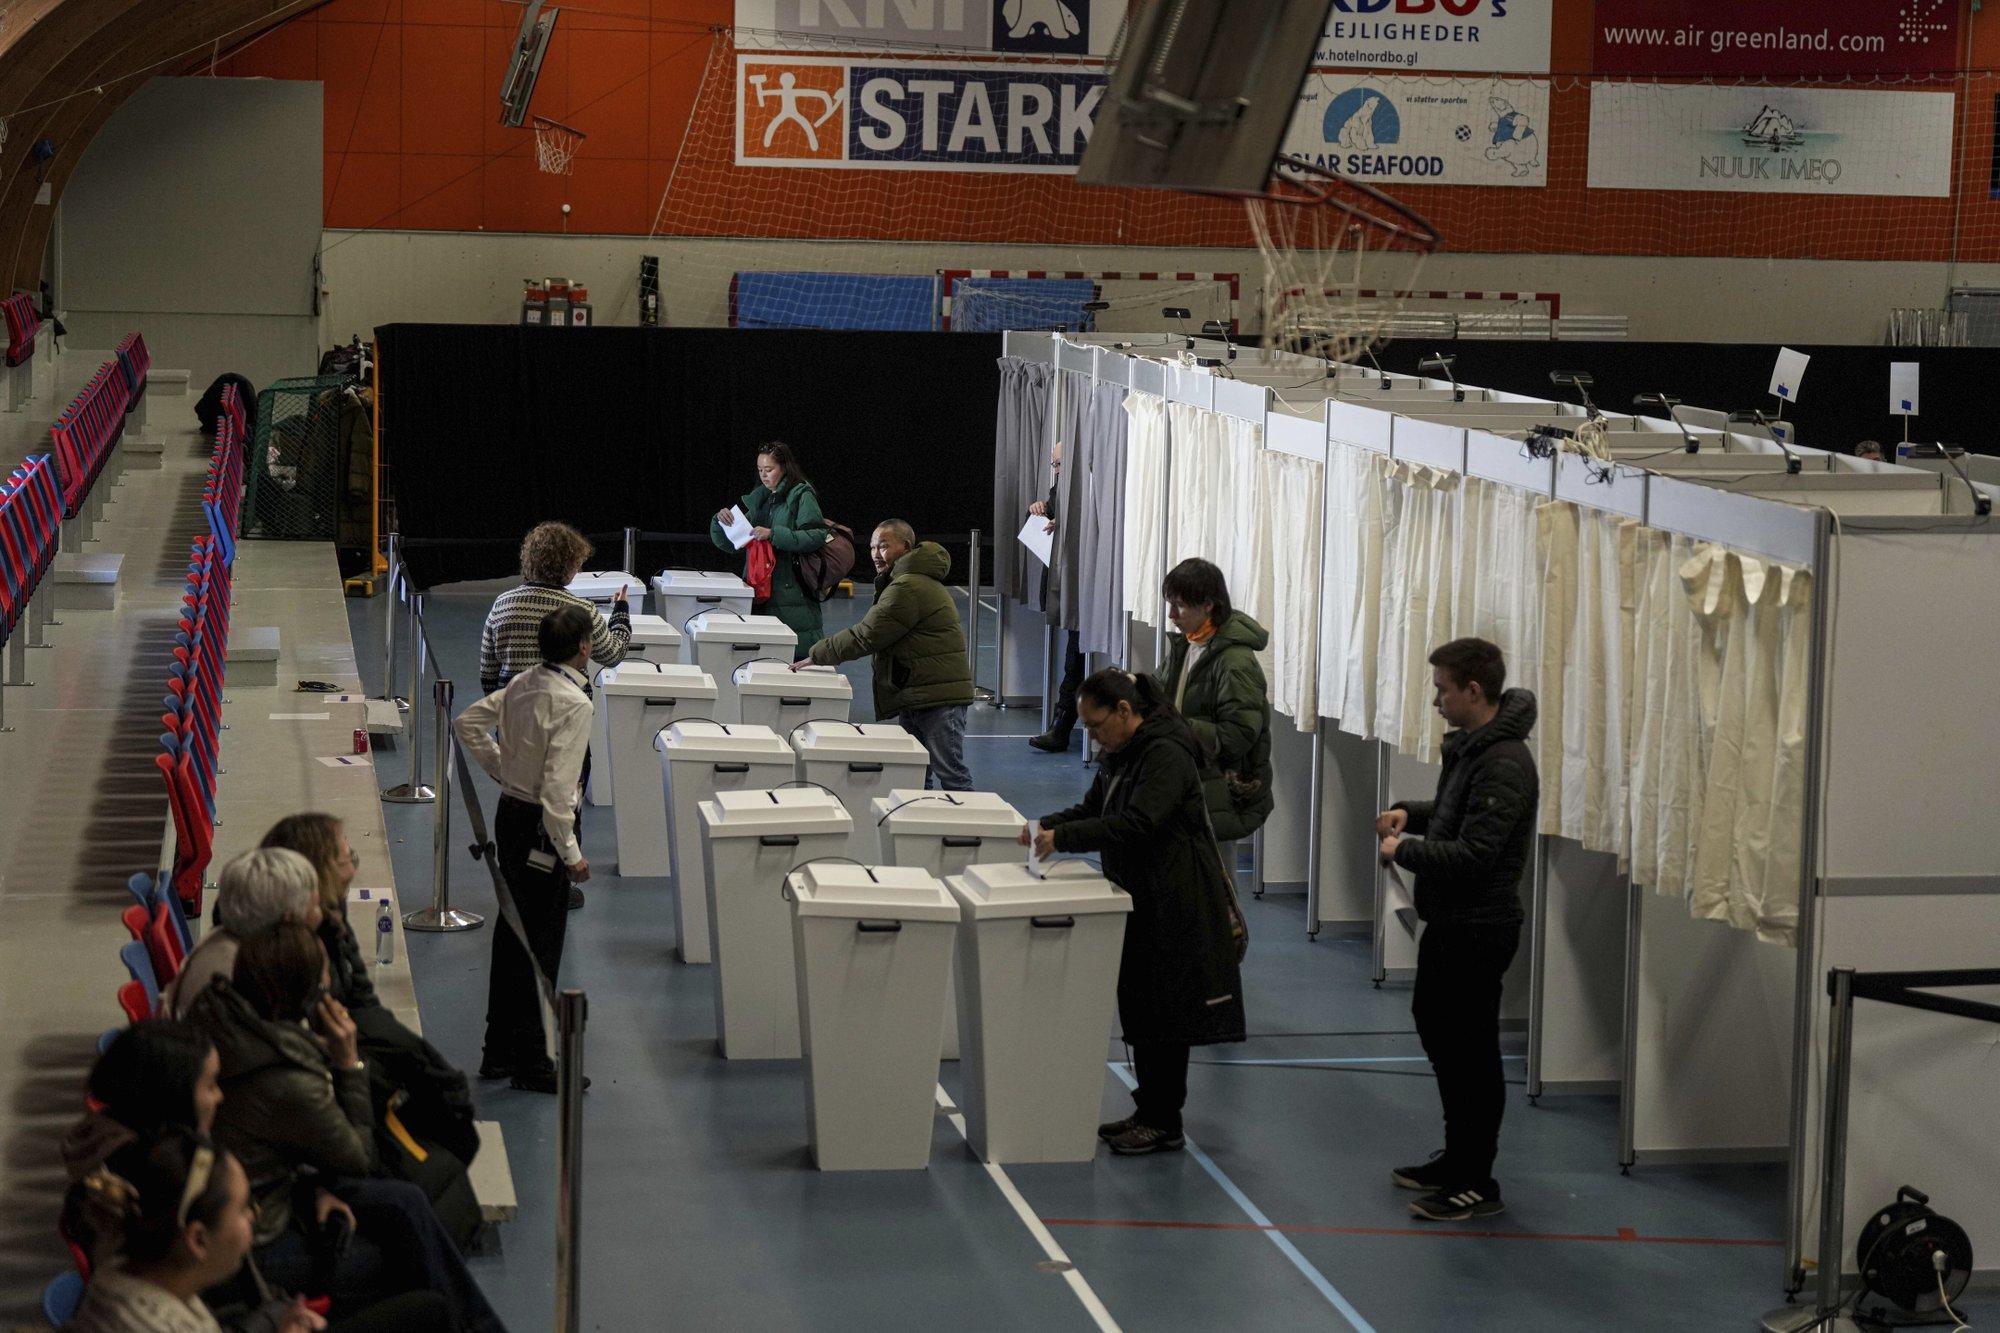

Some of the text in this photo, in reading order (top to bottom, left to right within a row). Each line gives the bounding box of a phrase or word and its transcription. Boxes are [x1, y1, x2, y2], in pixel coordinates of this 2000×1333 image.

[1312, 49, 1418, 66] w.hotelnordbo.gl
[858, 77, 1106, 155] STARK
[1347, 153, 1444, 176] SEAFOOD
[1700, 156, 1842, 184] NUUK IMEQ
